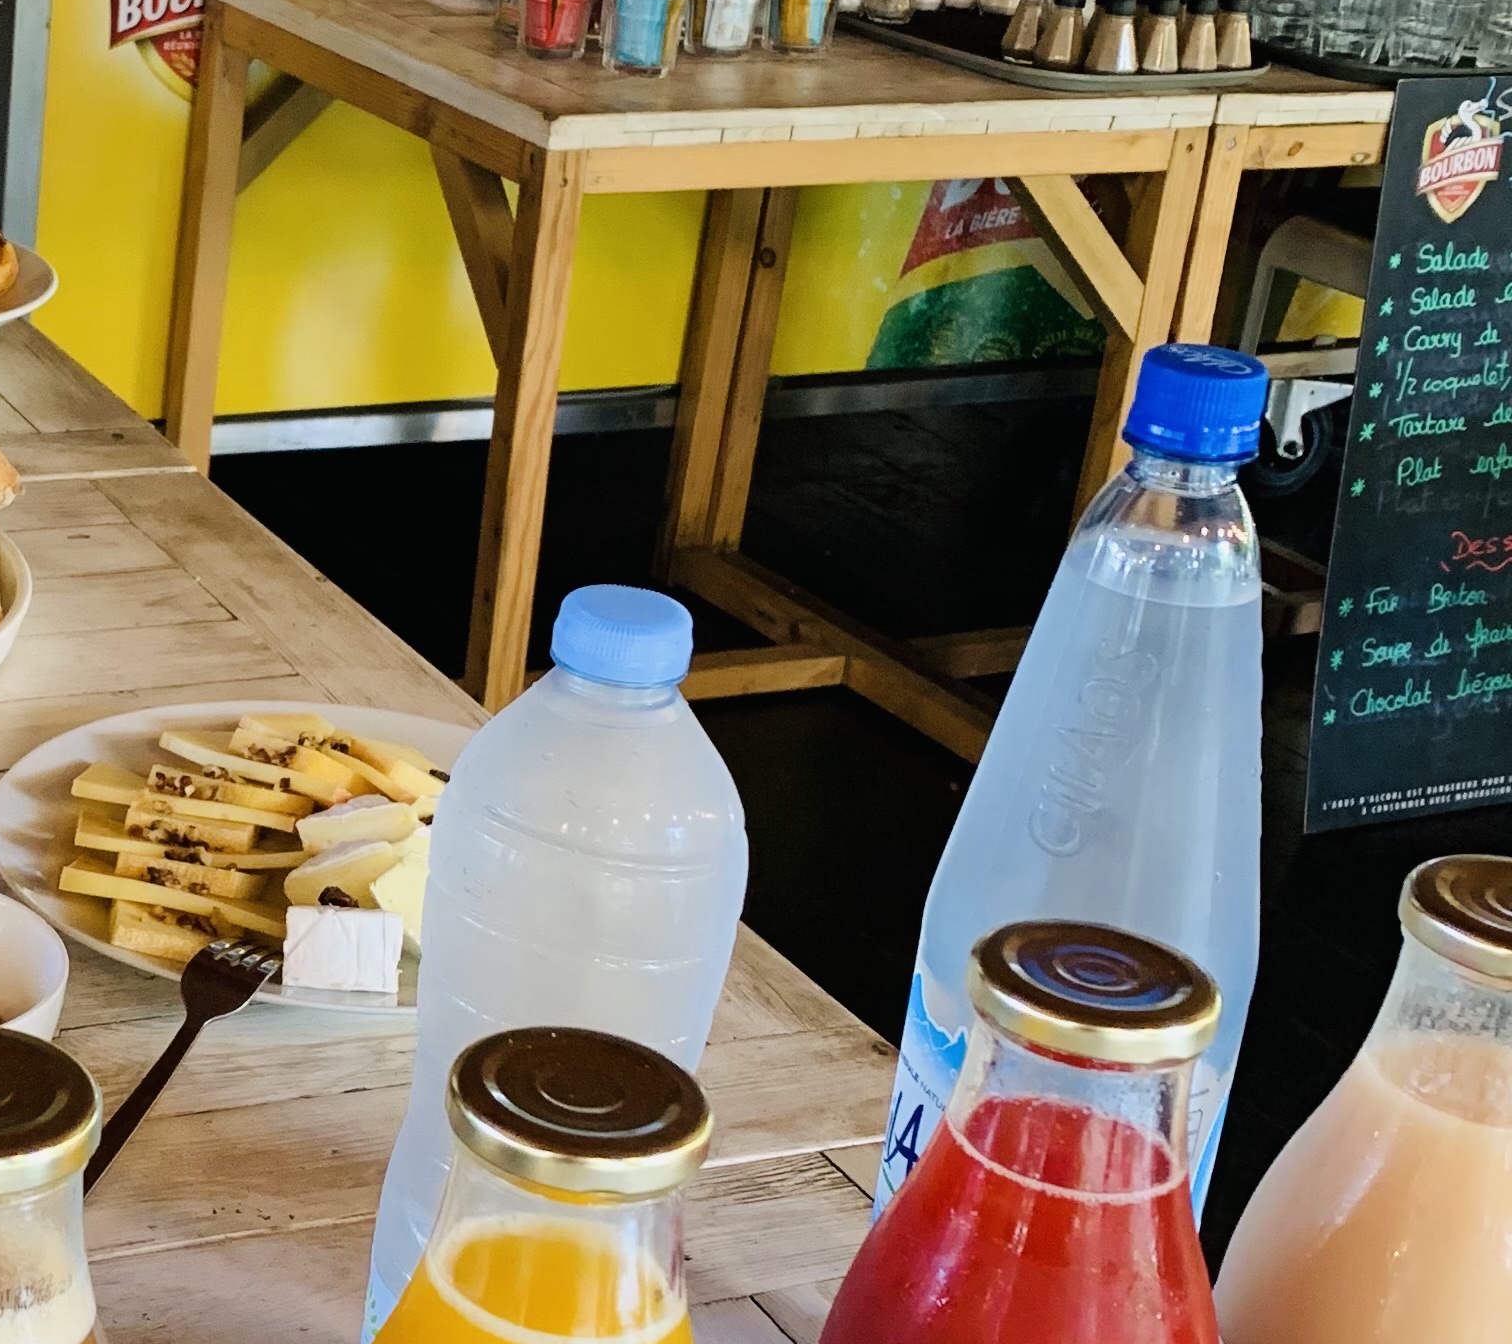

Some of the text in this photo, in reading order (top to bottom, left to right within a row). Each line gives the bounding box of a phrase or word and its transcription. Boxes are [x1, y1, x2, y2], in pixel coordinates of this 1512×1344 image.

[1419, 147, 1497, 189] BOURBON
[945, 221, 965, 240] LA
[1417, 241, 1491, 274] Salade
[1409, 284, 1478, 316] Salade
[1404, 321, 1502, 358] Carry de
[1350, 678, 1433, 717] Chocolat
